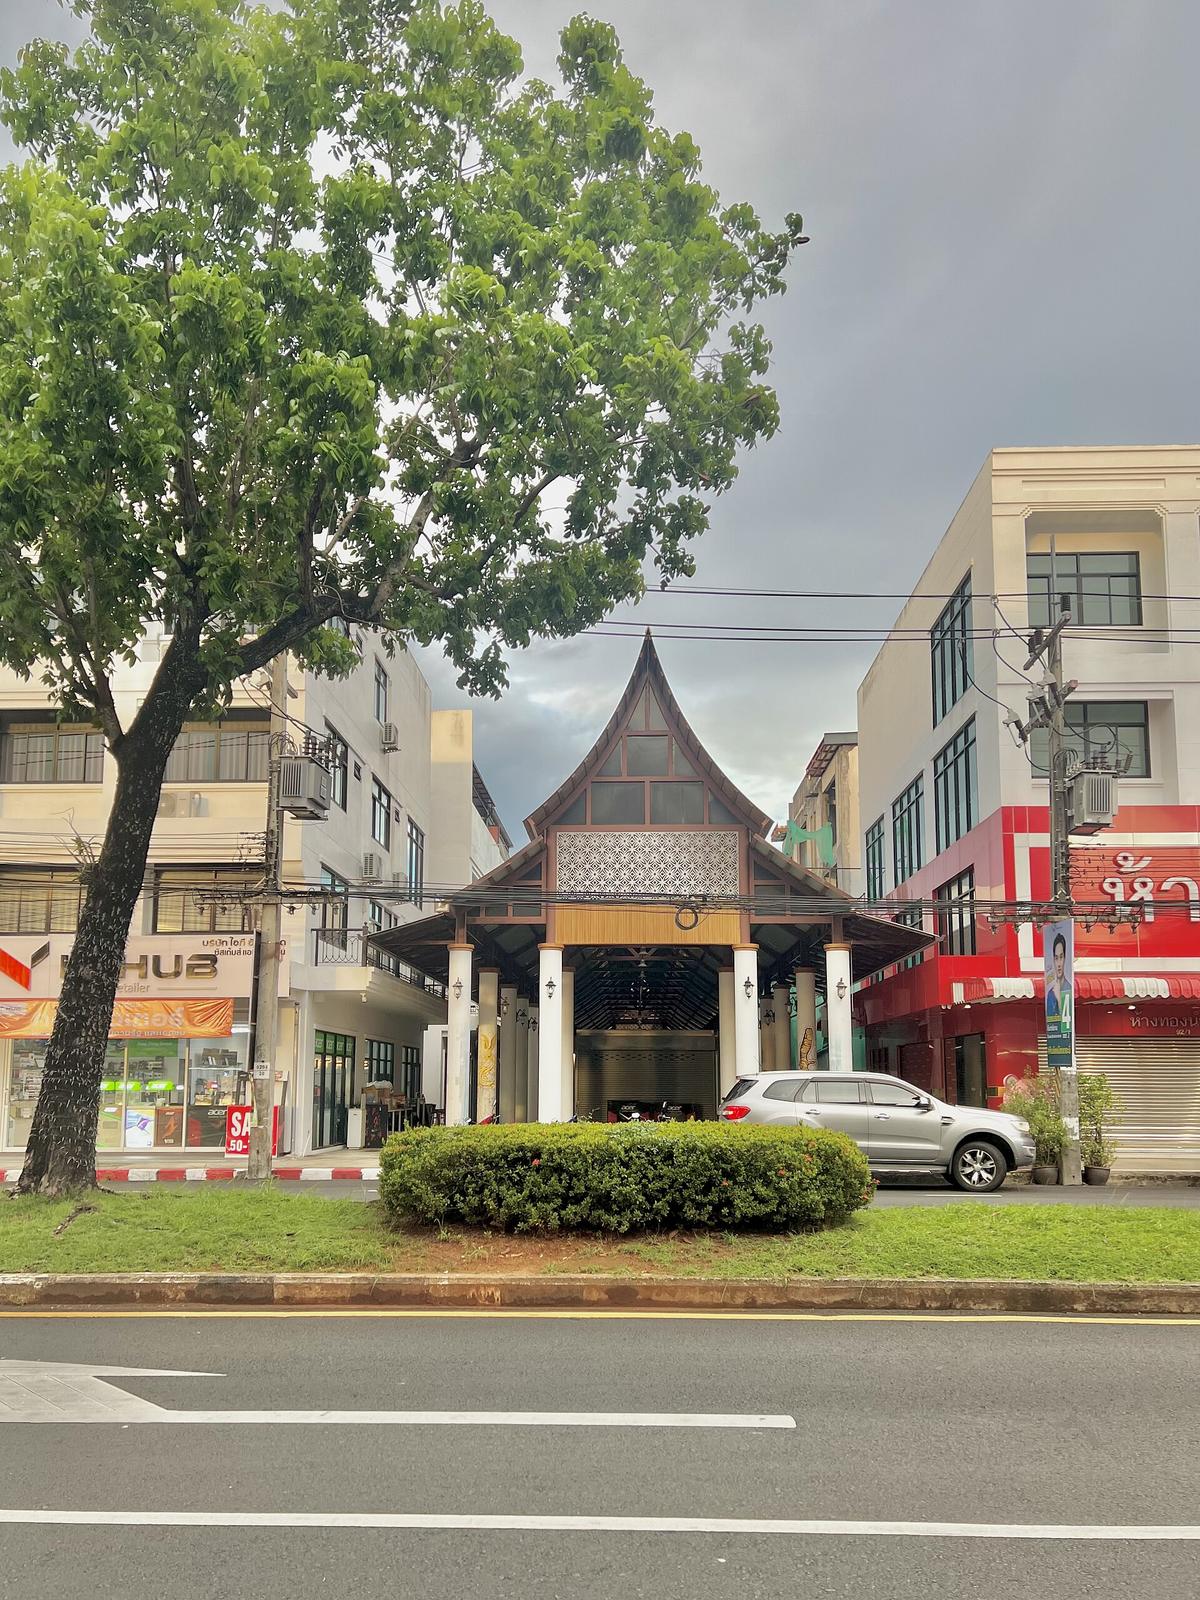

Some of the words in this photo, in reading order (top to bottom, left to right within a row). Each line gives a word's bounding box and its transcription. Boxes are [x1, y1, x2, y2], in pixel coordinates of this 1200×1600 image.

[117, 982, 151, 993] etailer
[1061, 993, 1071, 1029] 4
[230, 1111, 251, 1137] SA
